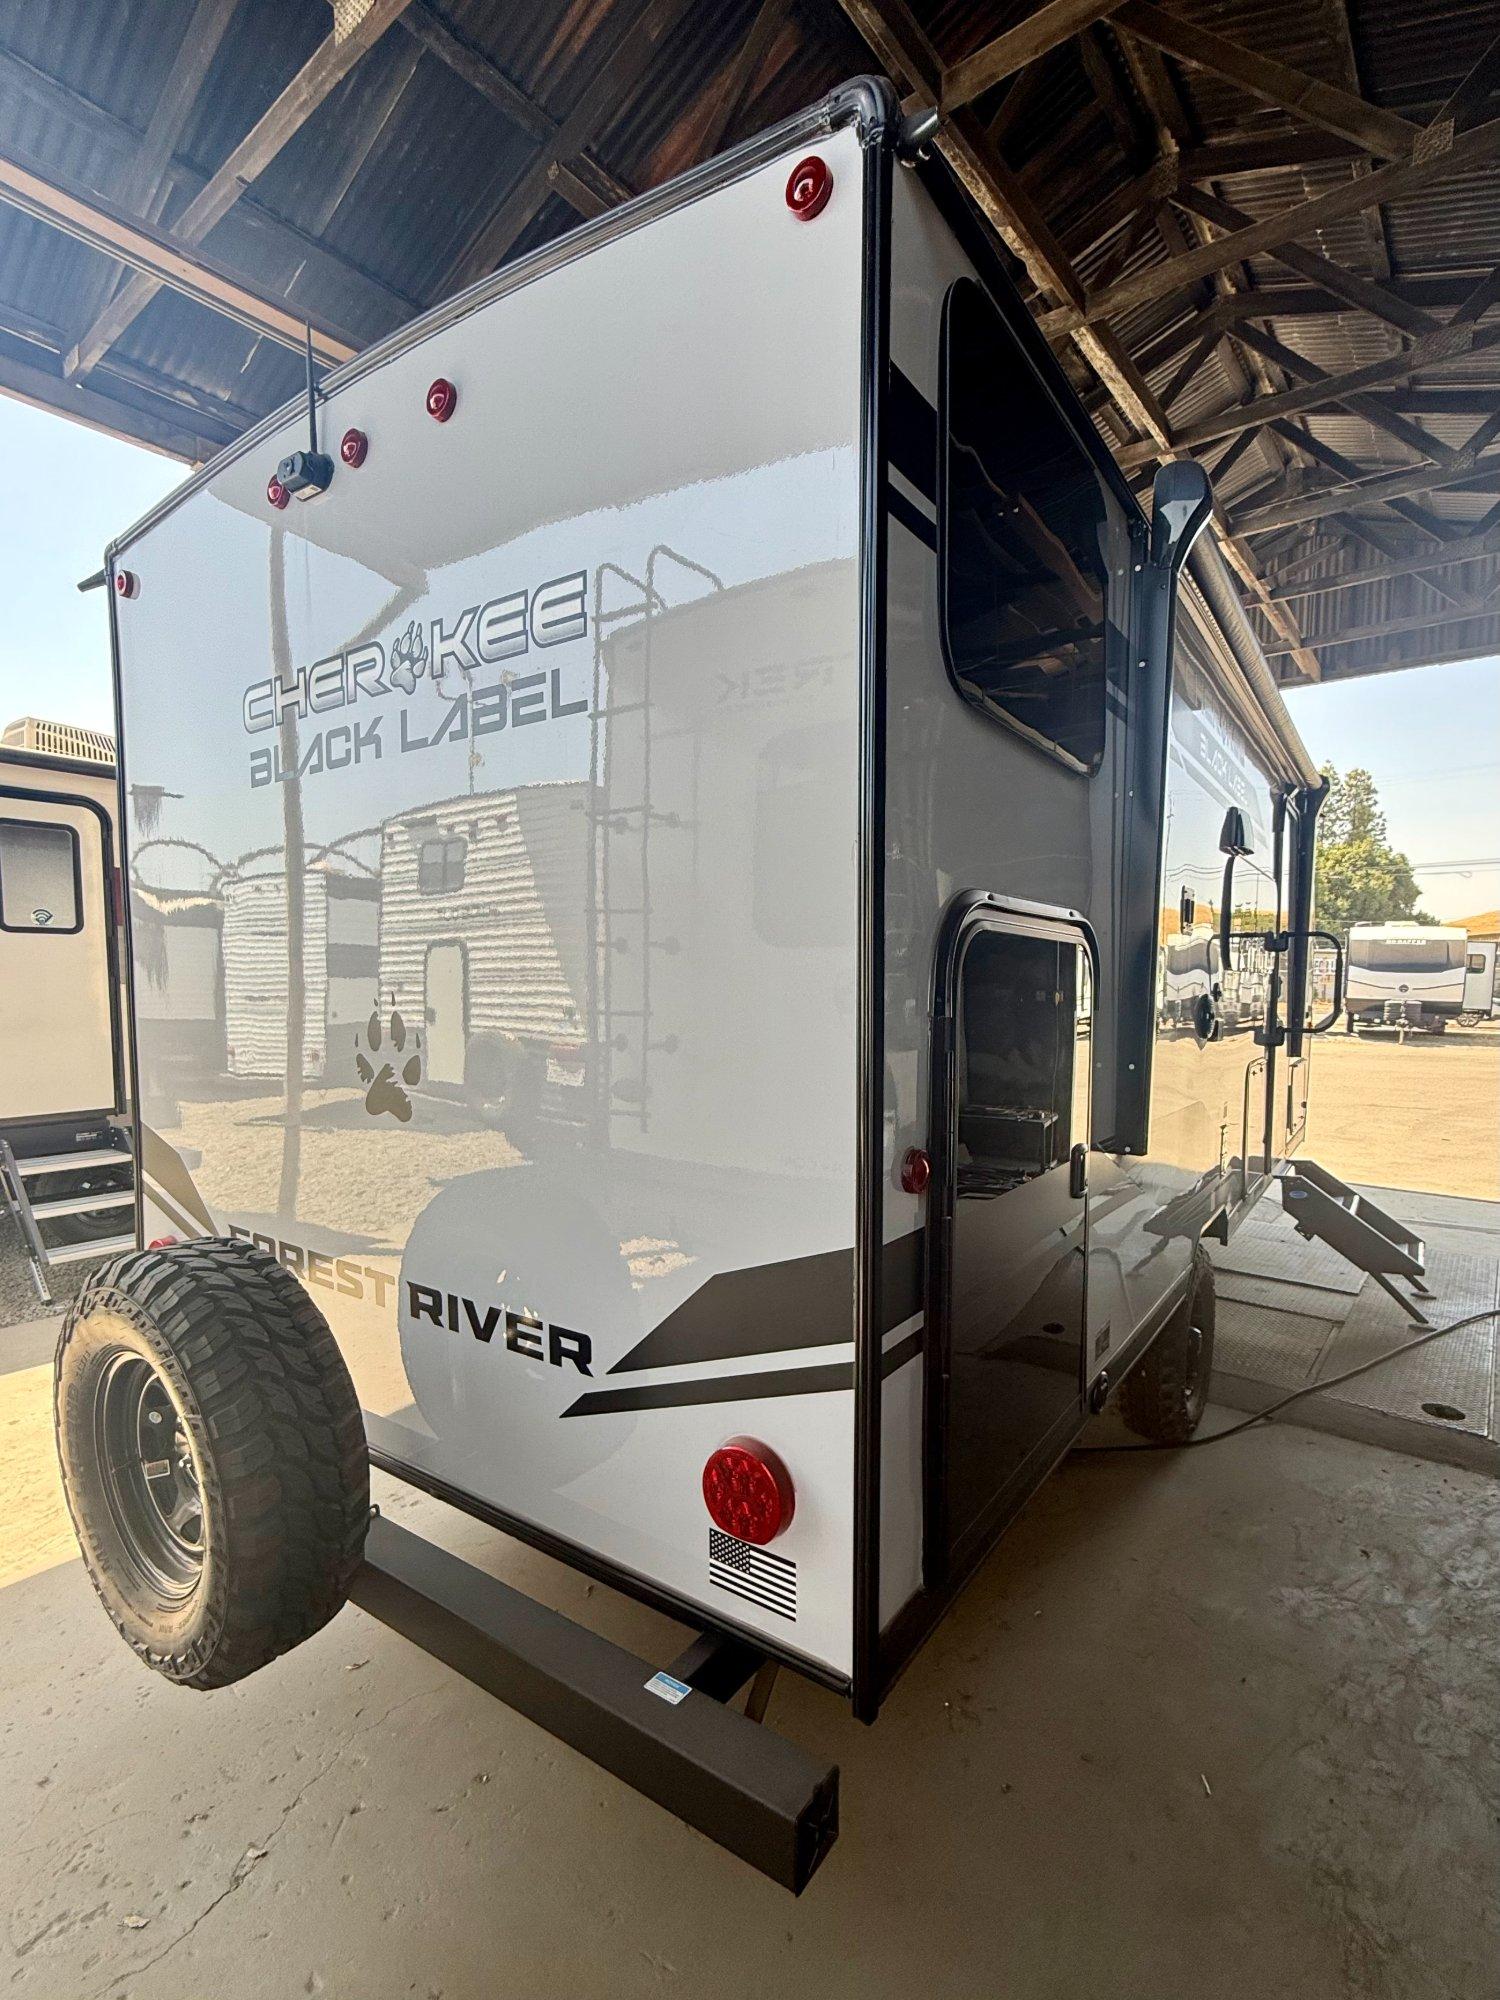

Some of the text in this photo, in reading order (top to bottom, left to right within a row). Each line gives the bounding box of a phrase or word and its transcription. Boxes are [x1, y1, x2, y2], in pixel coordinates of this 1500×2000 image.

[250, 668, 587, 788] BLACK LABEL
[407, 1281, 594, 1378] RIVER
